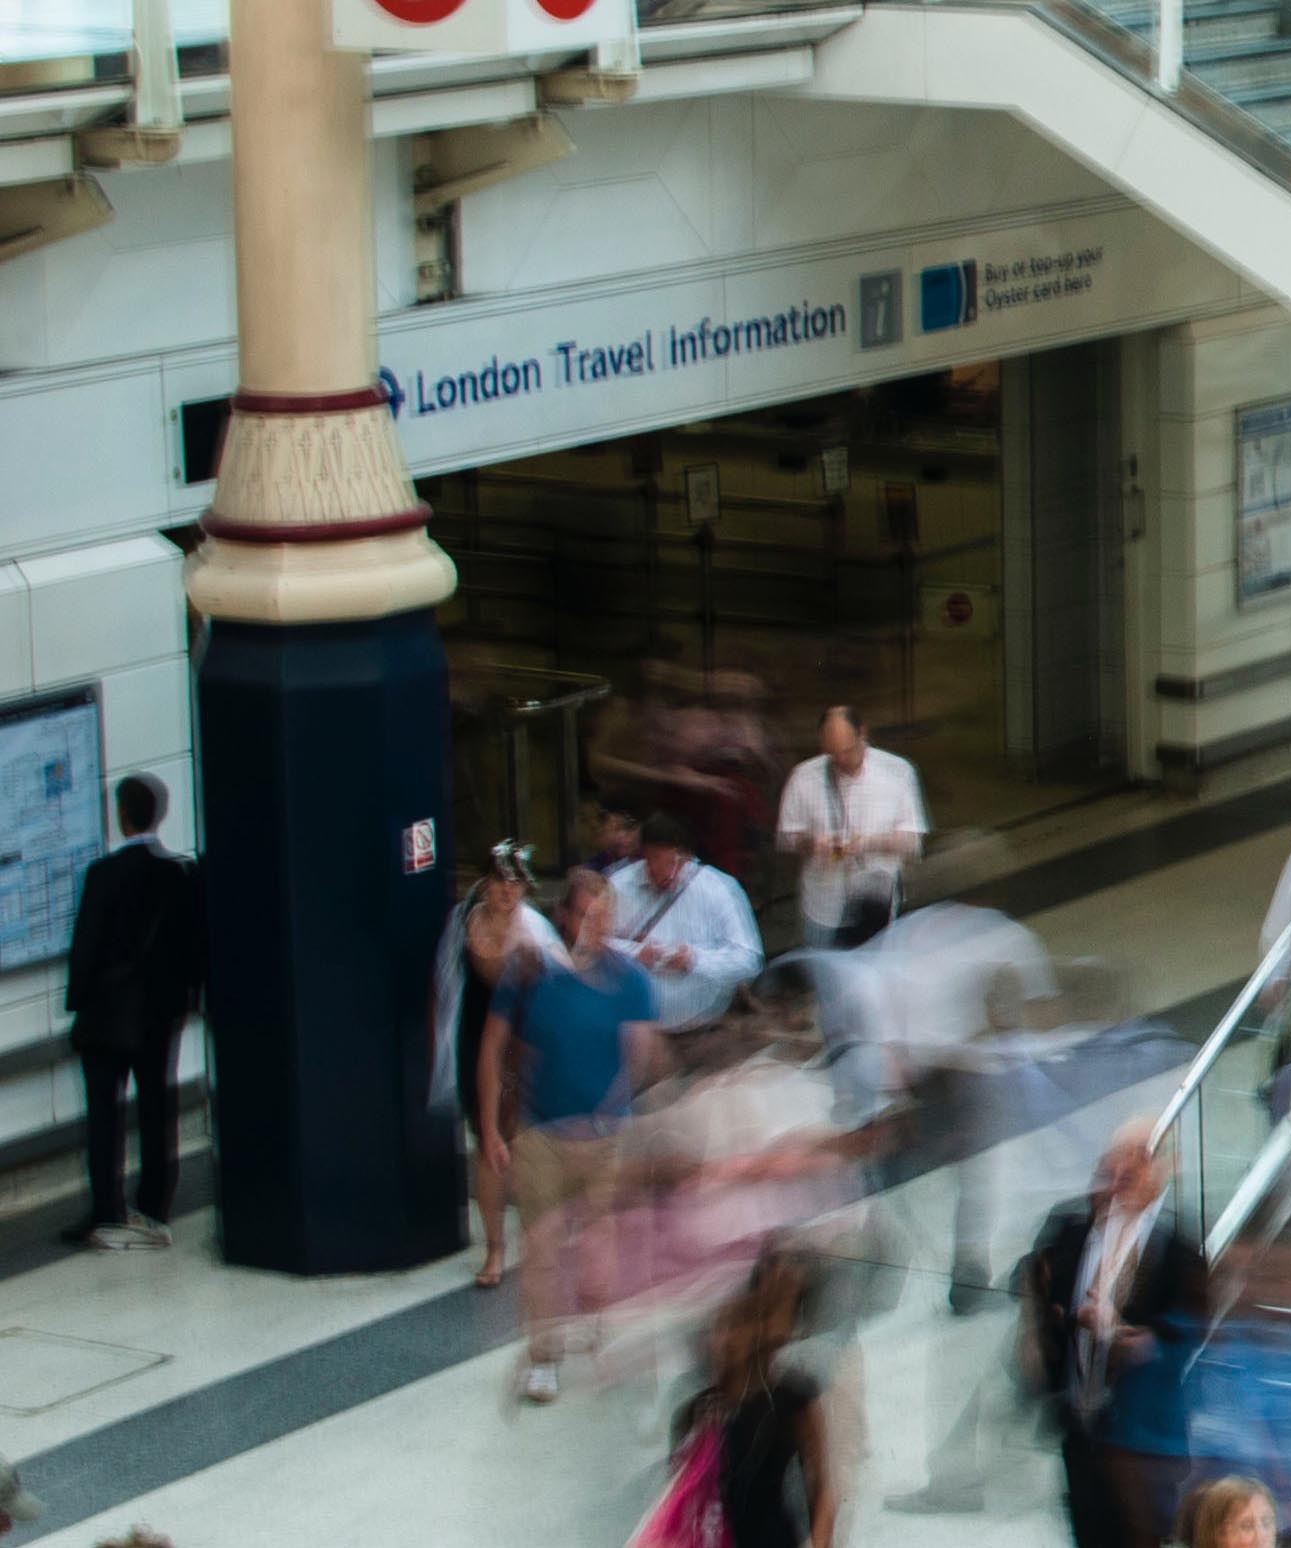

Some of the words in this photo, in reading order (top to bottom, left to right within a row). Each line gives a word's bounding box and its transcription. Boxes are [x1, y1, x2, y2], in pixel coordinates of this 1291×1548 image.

[984, 263, 1008, 282] Buy
[1012, 260, 1025, 277] or
[1030, 253, 1074, 274] top-up
[1077, 247, 1104, 267] your
[985, 286, 1029, 309] Oyster
[1033, 276, 1061, 298] card
[1064, 273, 1093, 291] here
[417, 353, 542, 415] London
[556, 329, 654, 384] Travel
[669, 301, 847, 367] Information
